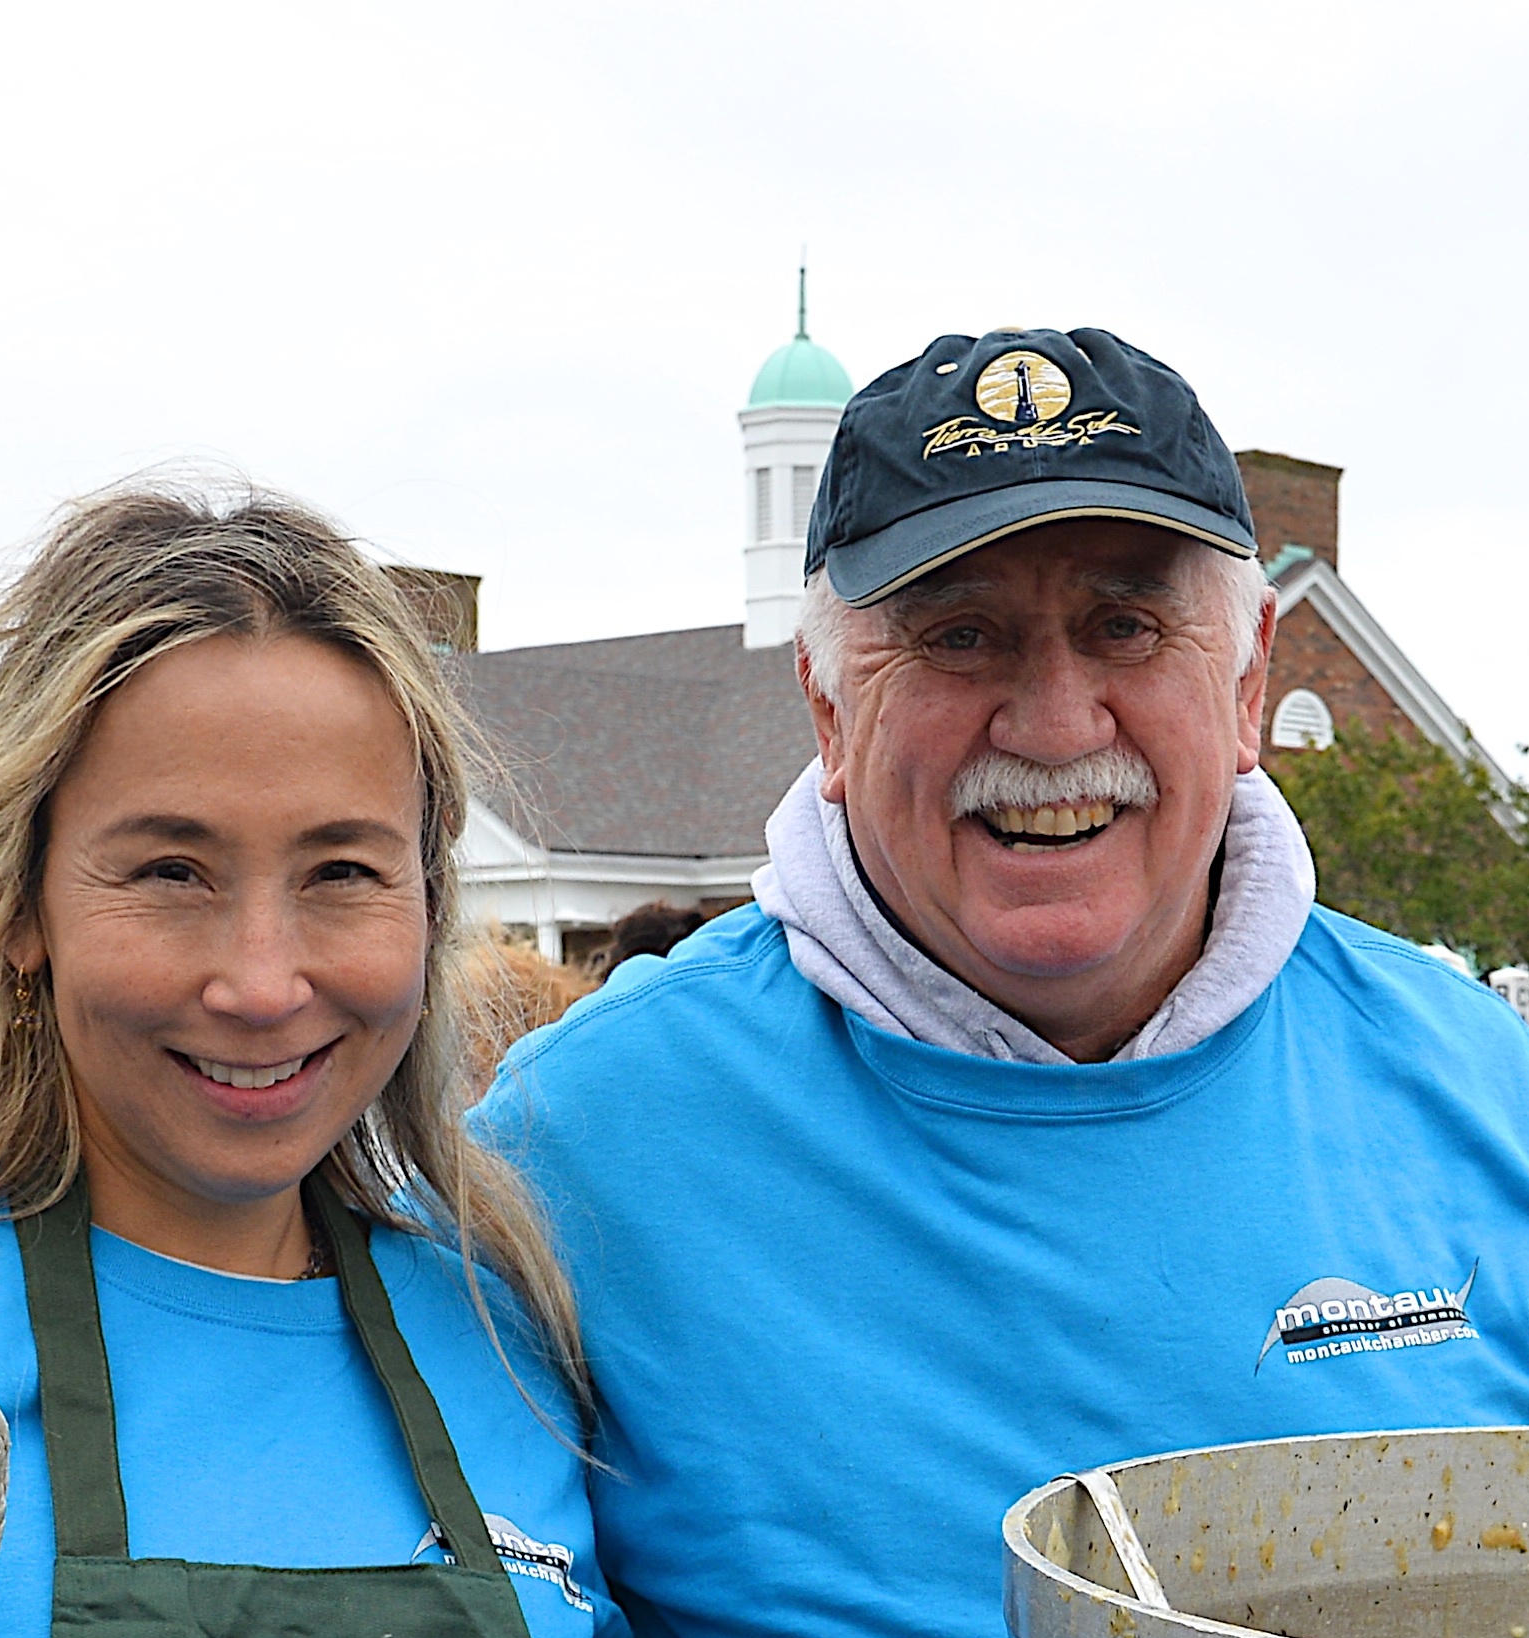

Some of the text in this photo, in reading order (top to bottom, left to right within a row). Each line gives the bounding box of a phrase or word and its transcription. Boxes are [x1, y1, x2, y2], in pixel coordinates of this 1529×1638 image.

[922, 410, 1142, 460] Tierra del Sol
[1276, 1288, 1463, 1330] montauk
[1322, 1310, 1468, 1335] chamber of commer
